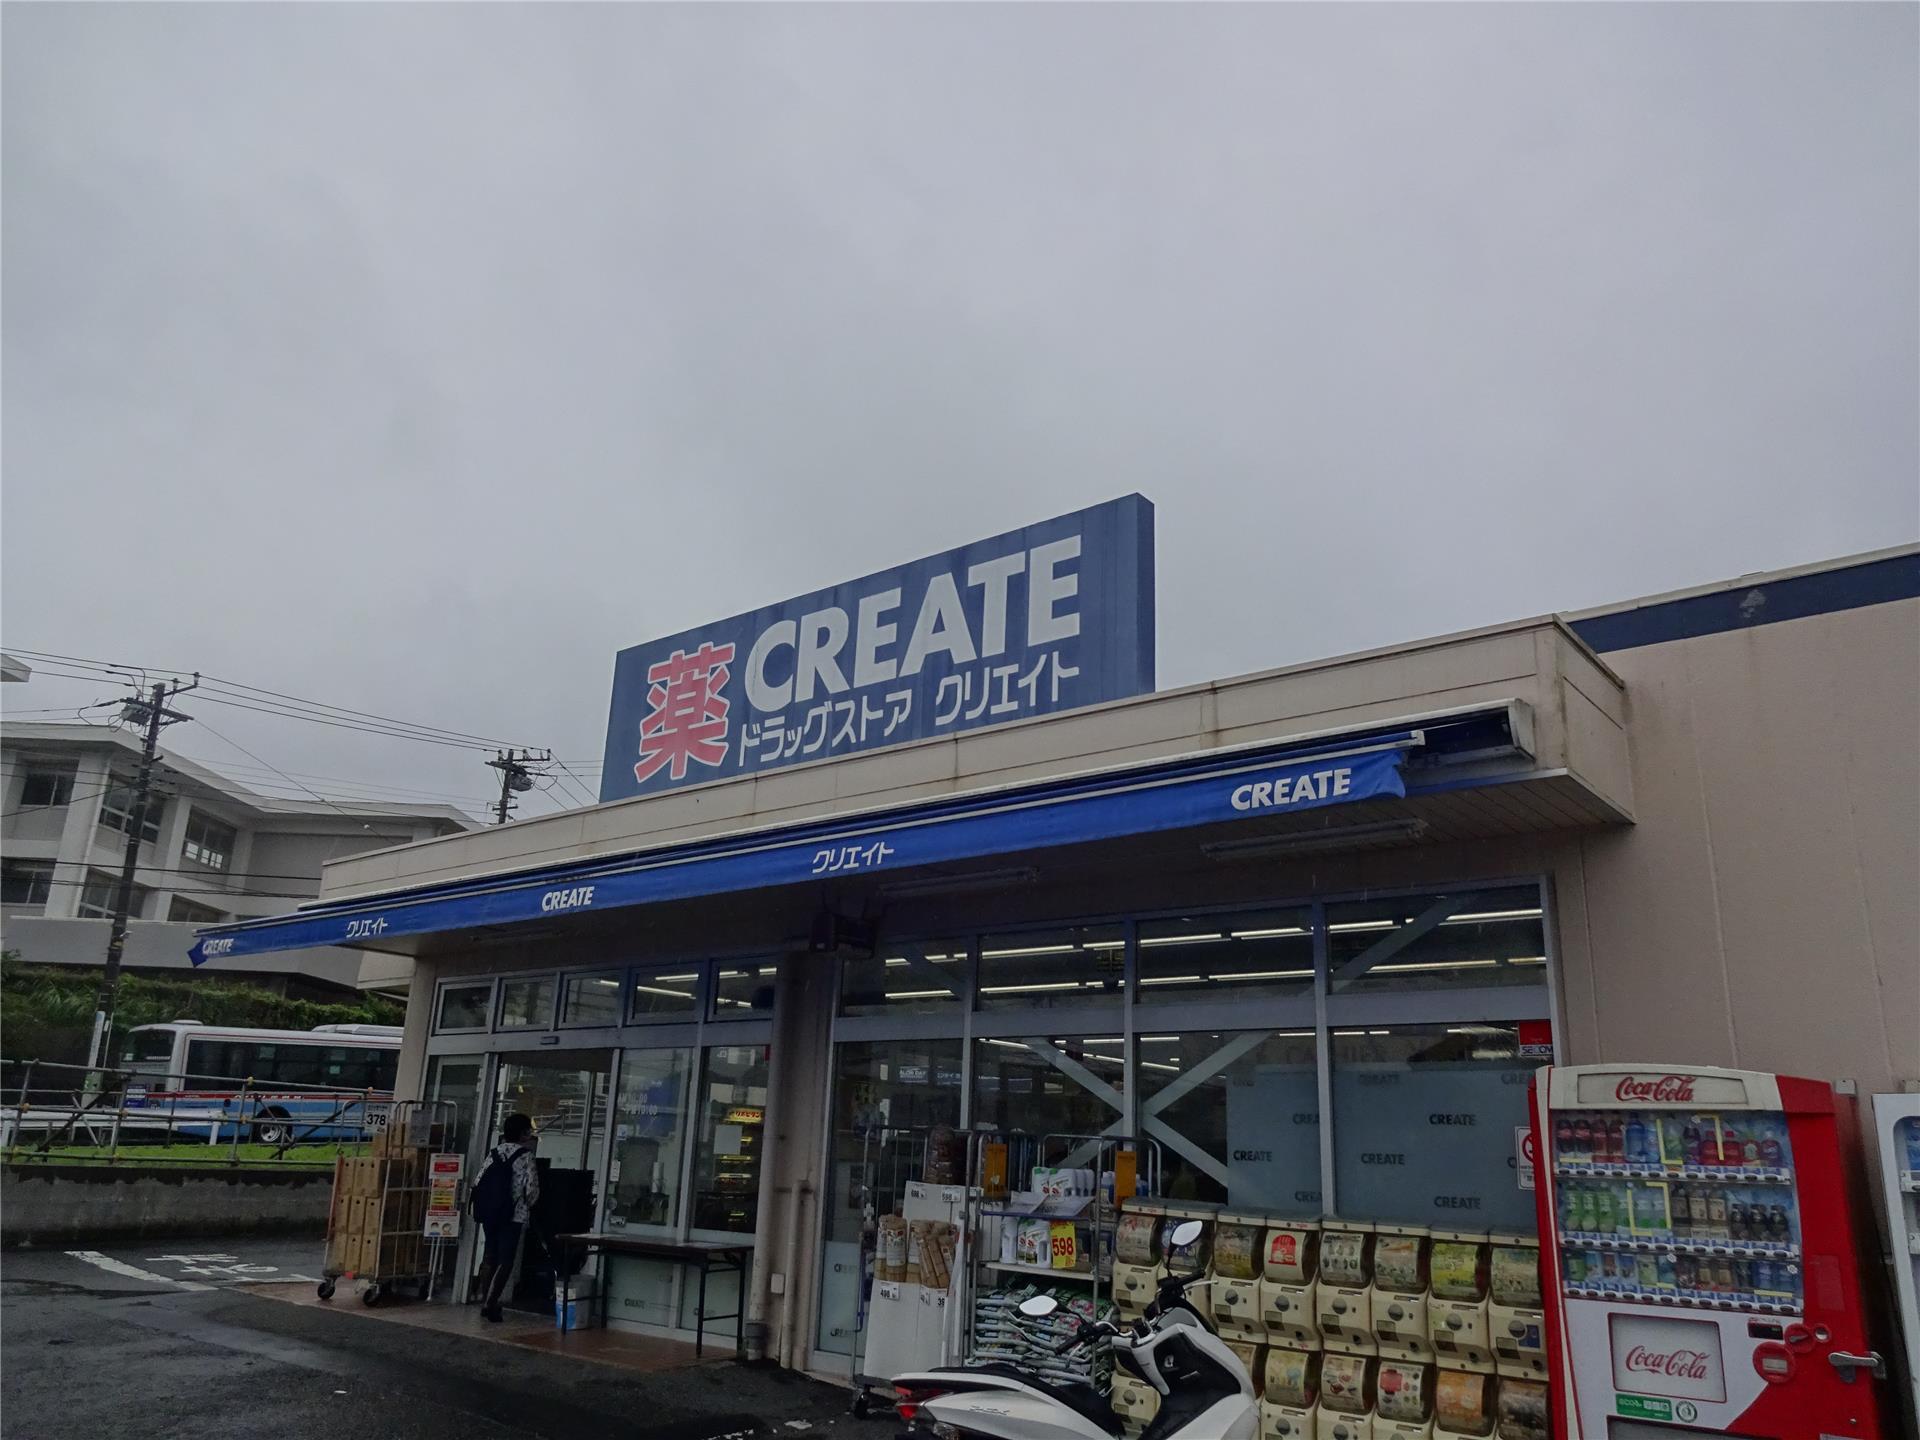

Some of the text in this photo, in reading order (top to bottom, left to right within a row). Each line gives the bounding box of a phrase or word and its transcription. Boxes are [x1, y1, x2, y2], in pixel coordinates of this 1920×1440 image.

[744, 535, 1081, 712] CREATE
[634, 641, 736, 783] 薬
[739, 652, 1080, 767] ドラッグストア クリエイト
[1231, 768, 1352, 811] CREATE
[812, 841, 895, 875] クリエイト
[541, 886, 595, 912] CREATE
[346, 916, 388, 939] クリエイト
[202, 938, 234, 955] CREATE
[1522, 1045, 1553, 1054] SEOM
[1616, 1076, 1696, 1102] Coca-Cola
[367, 1113, 386, 1126] 378
[1429, 1113, 1476, 1126] CREATE
[1233, 1150, 1273, 1162] CREATE
[1361, 1153, 1405, 1166] CREATE
[1434, 1196, 1480, 1209] CREATE
[1052, 1237, 1073, 1256] 598
[1626, 1345, 1711, 1379] Coca-Cola
